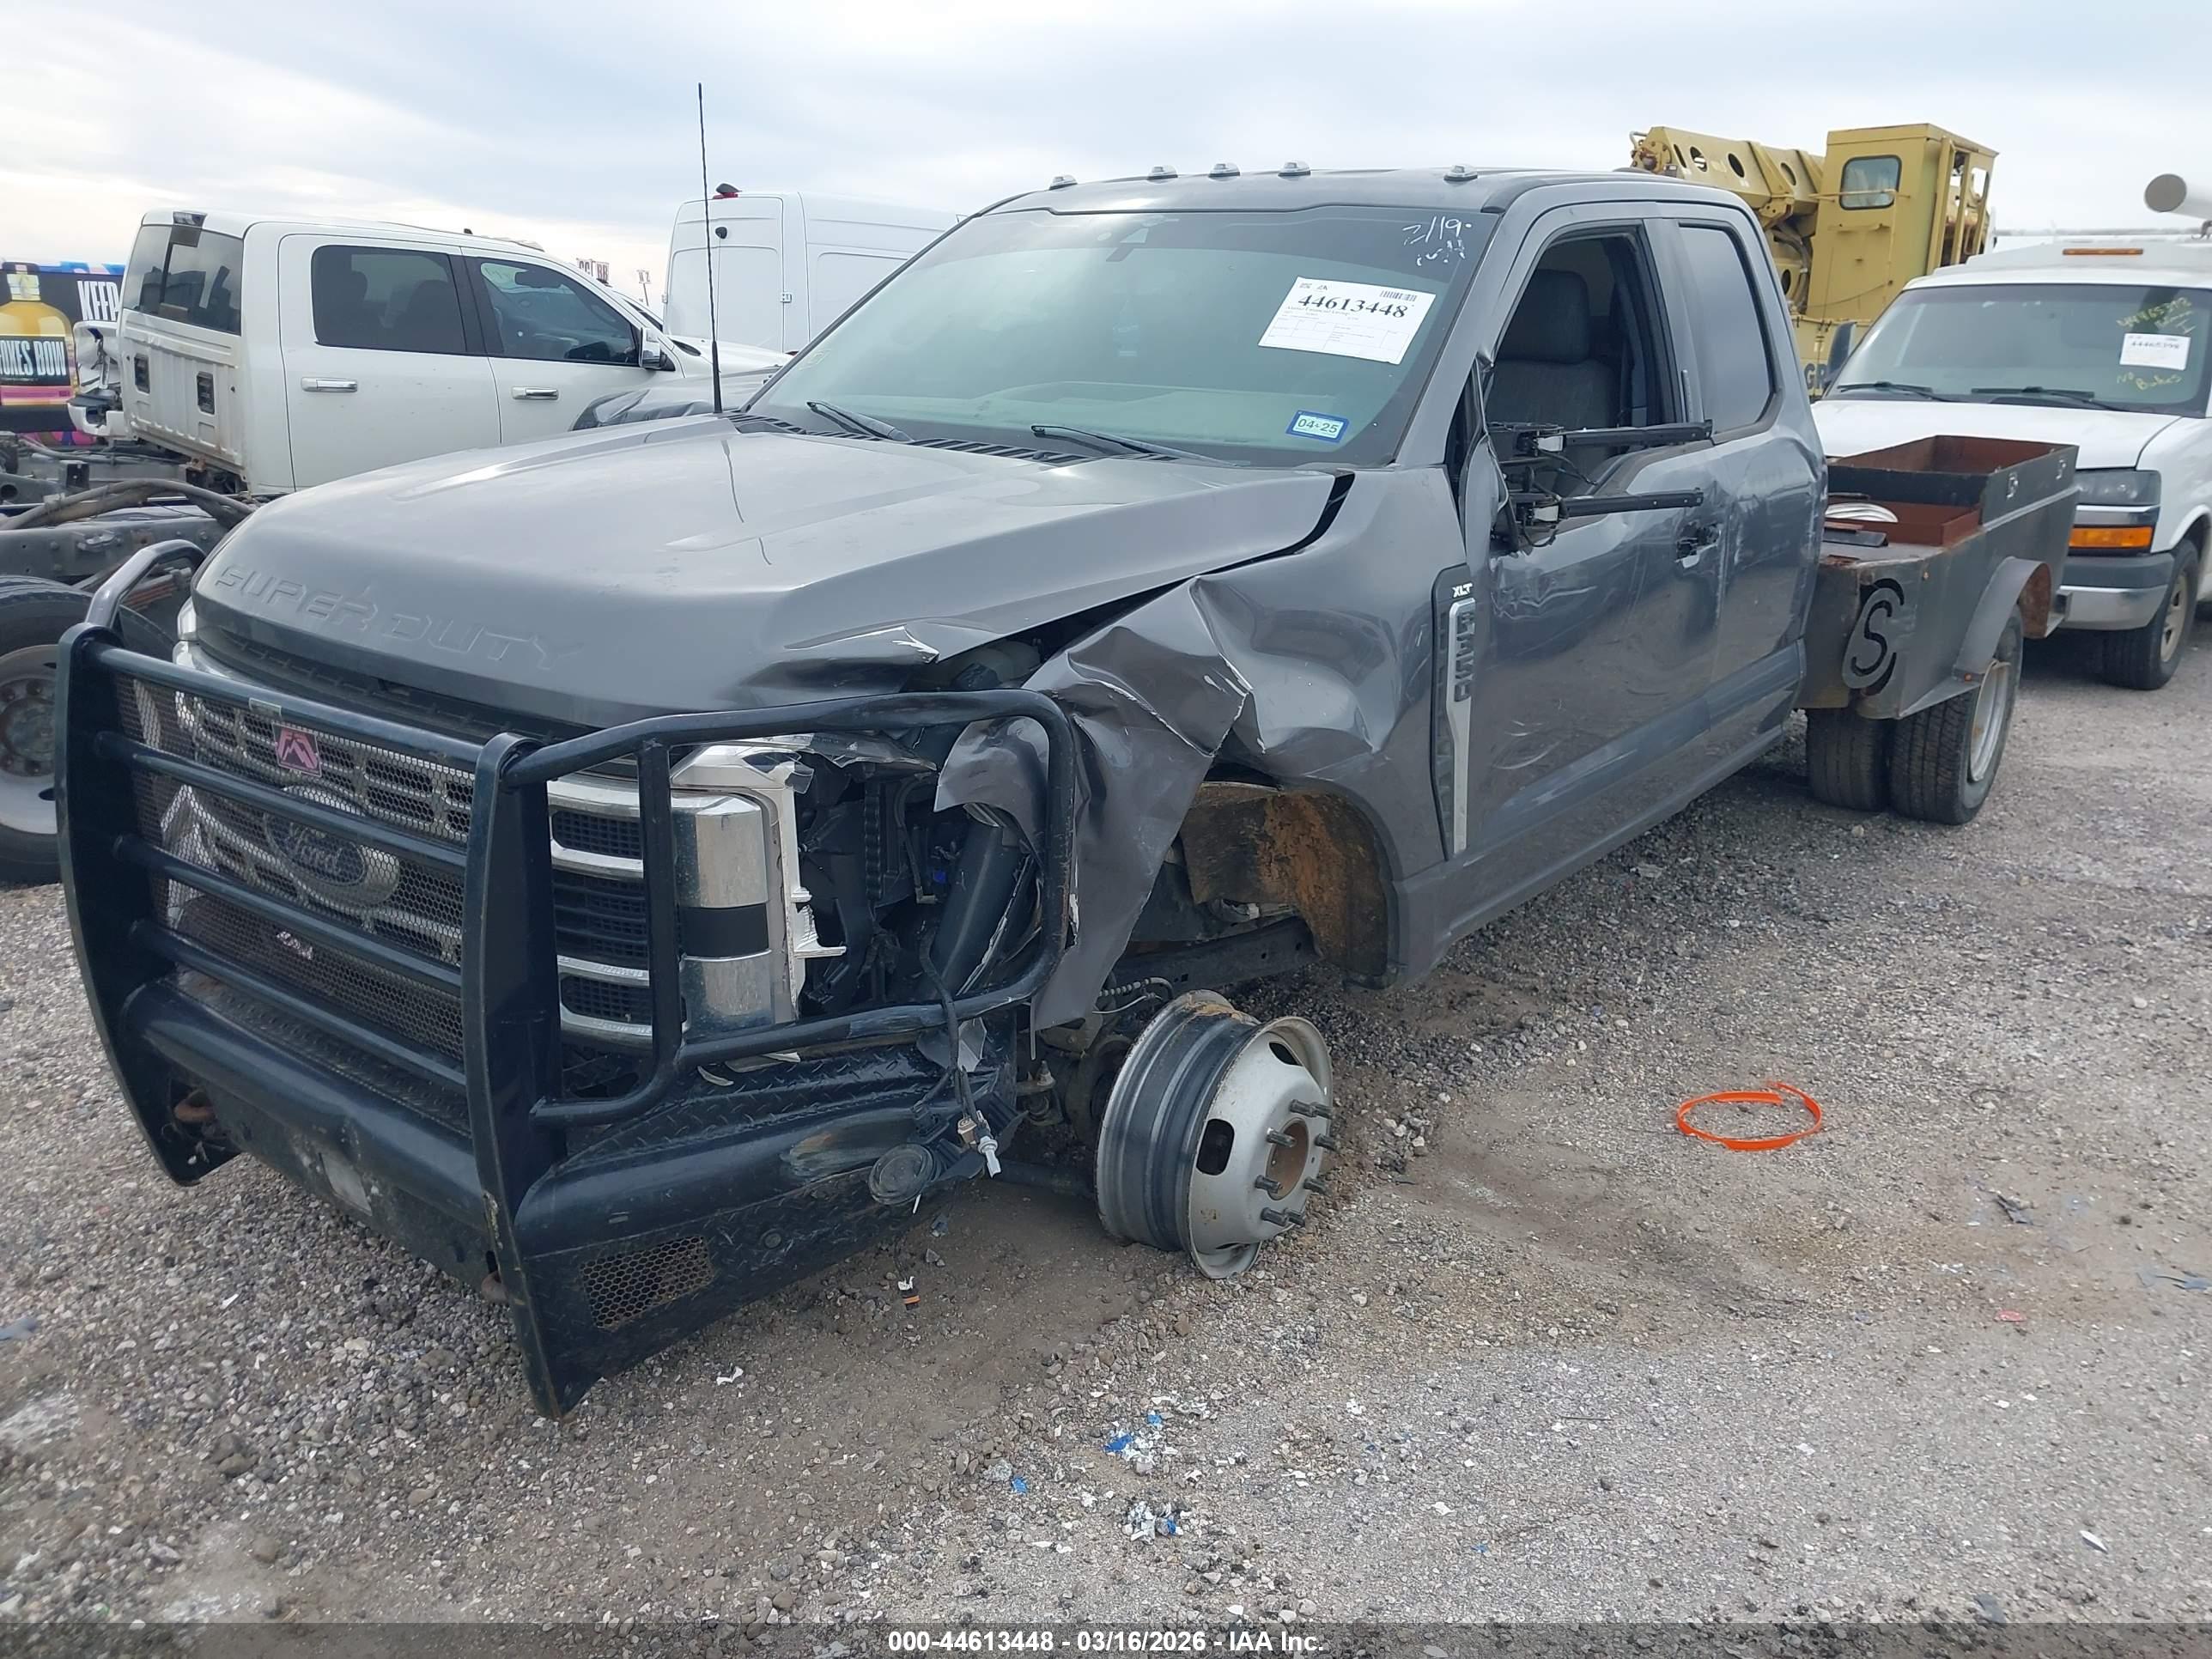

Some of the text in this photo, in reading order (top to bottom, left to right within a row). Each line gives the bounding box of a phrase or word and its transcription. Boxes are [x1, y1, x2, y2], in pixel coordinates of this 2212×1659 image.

[1297, 295, 1408, 319] 44613448
[33, 341, 67, 376] BOW
[1452, 583, 1473, 598] XLT
[214, 563, 585, 672] SUPER DUTY
